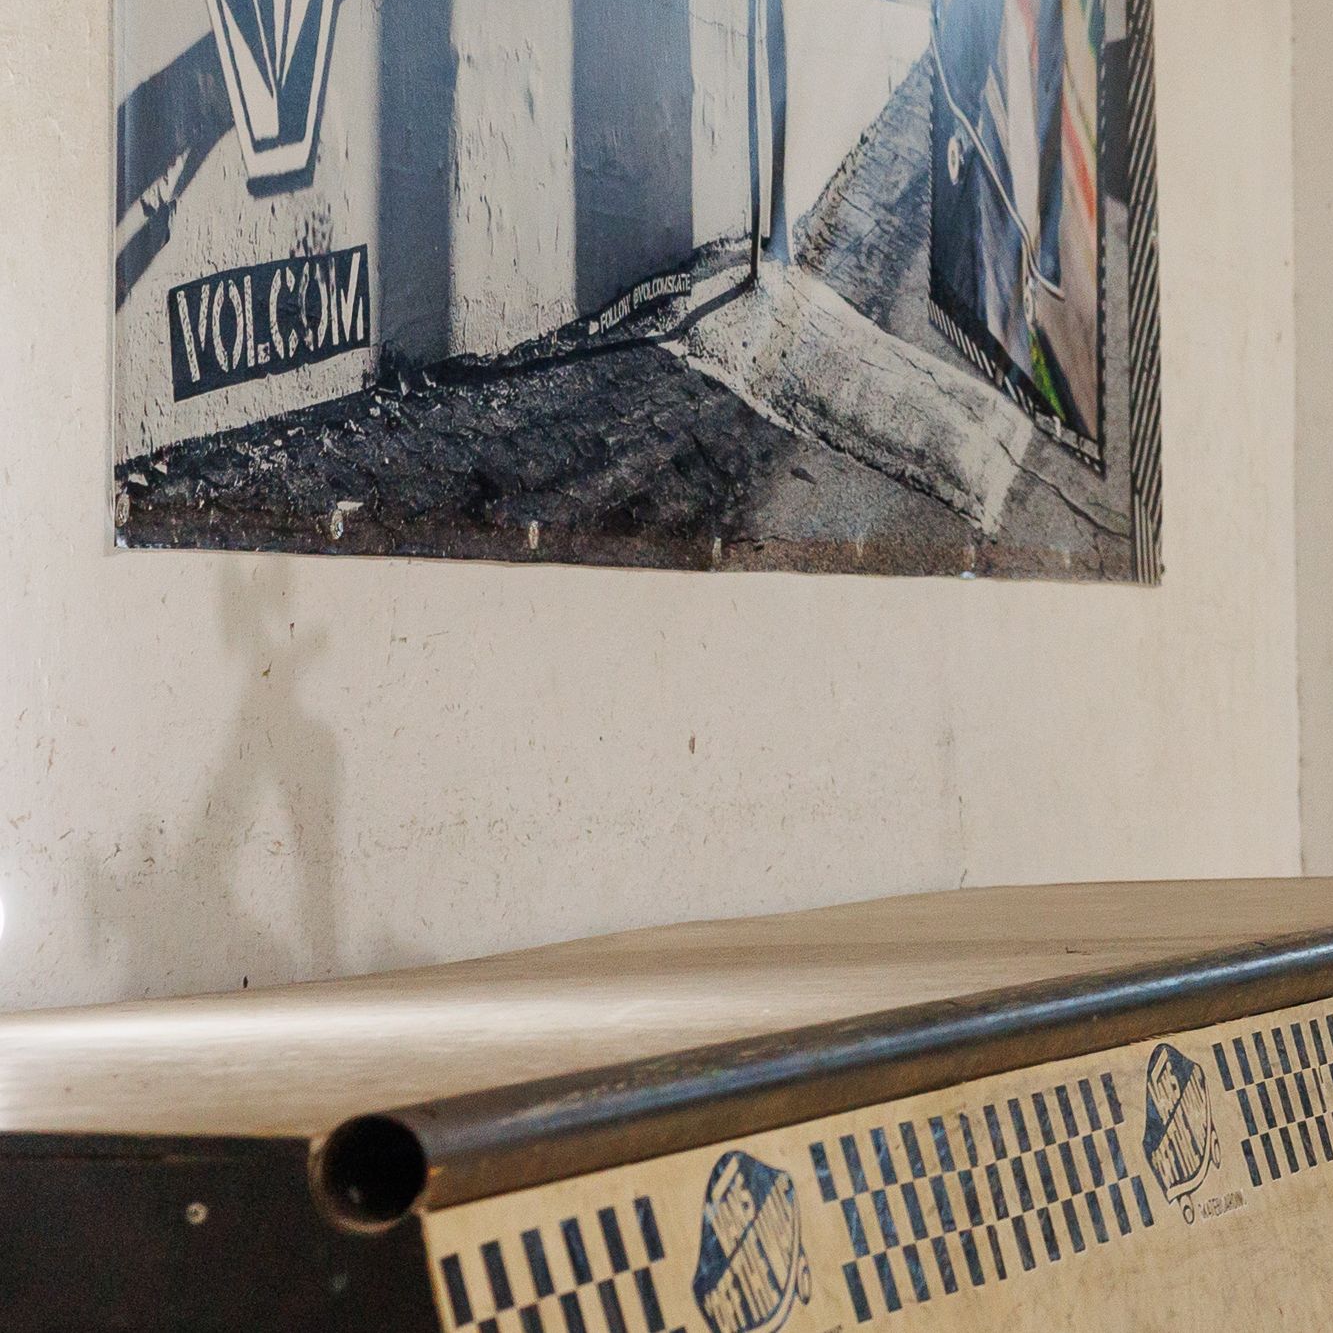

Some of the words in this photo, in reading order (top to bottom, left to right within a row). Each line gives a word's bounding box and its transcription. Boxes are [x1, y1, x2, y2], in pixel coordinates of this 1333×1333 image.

[176, 251, 364, 384] VOLCOM
[600, 293, 631, 334] FOLLOW
[632, 272, 691, 310] @VOLCOMSKATE
